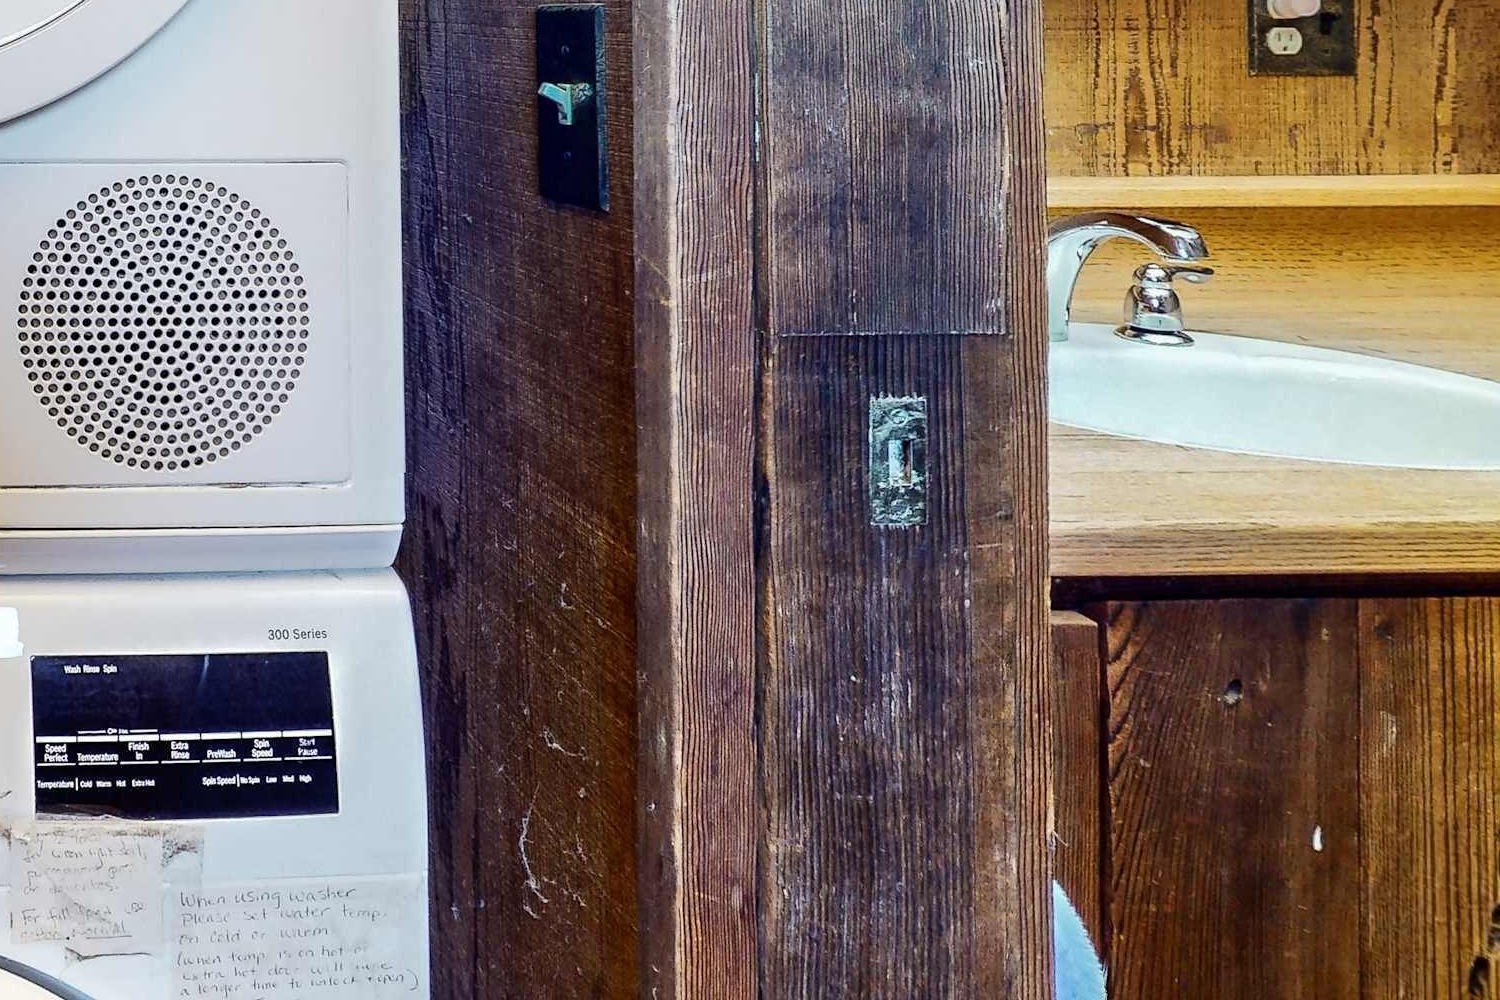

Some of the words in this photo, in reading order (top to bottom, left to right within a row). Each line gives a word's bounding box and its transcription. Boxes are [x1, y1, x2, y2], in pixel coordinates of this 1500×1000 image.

[268, 629, 290, 640] 300
[292, 628, 328, 640] Series
[64, 664, 82, 674] Wash
[102, 663, 118, 674] Spin
[44, 743, 67, 754] Speed
[127, 741, 150, 752] Finish
[170, 741, 189, 751] Extra
[253, 738, 271, 749] Spin
[43, 753, 69, 763] Perfect
[76, 752, 119, 763] Temperature
[170, 750, 190, 760] Rinse
[206, 748, 237, 759] PreWash
[251, 747, 274, 758] Speed
[36, 779, 75, 789] Temperature
[79, 779, 93, 788] Cold
[202, 776, 216, 787] Spin
[216, 775, 236, 787] Speed
[179, 891, 226, 908] When
[234, 890, 281, 910] using
[289, 884, 357, 904] washer
[180, 911, 230, 928] Please
[279, 905, 332, 920] water
[210, 928, 241, 944] cold
[251, 929, 267, 941] or
[279, 926, 329, 939] warm
[278, 950, 291, 960] is
[298, 949, 315, 959] on
[321, 945, 344, 957] hot
[234, 966, 258, 978] hot
[180, 987, 190, 997] a
[197, 982, 242, 999] longer
[251, 979, 278, 991] time
